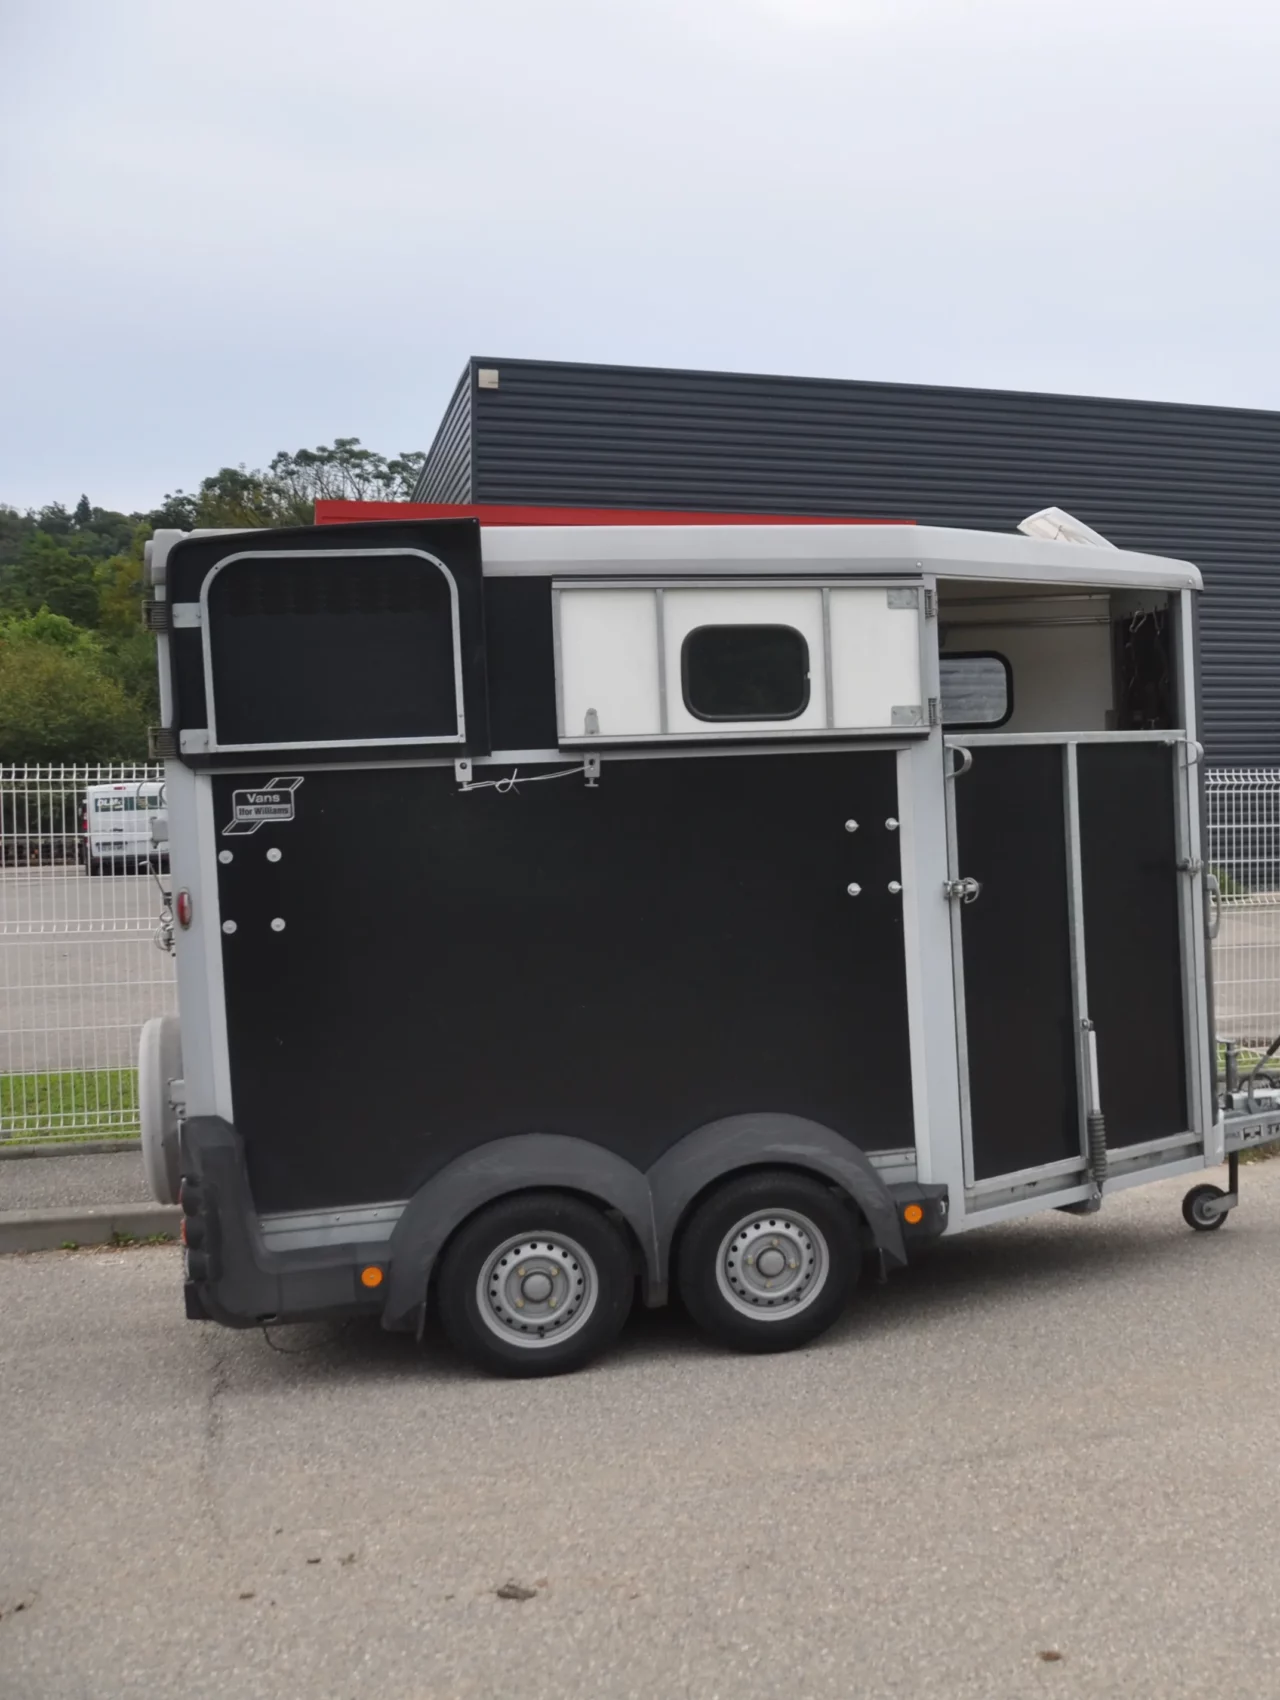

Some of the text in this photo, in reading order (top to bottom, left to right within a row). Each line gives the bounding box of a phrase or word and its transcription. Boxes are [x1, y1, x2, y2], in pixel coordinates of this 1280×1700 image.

[246, 793, 280, 803] Vans
[238, 806, 289, 816] Ifor Williams
